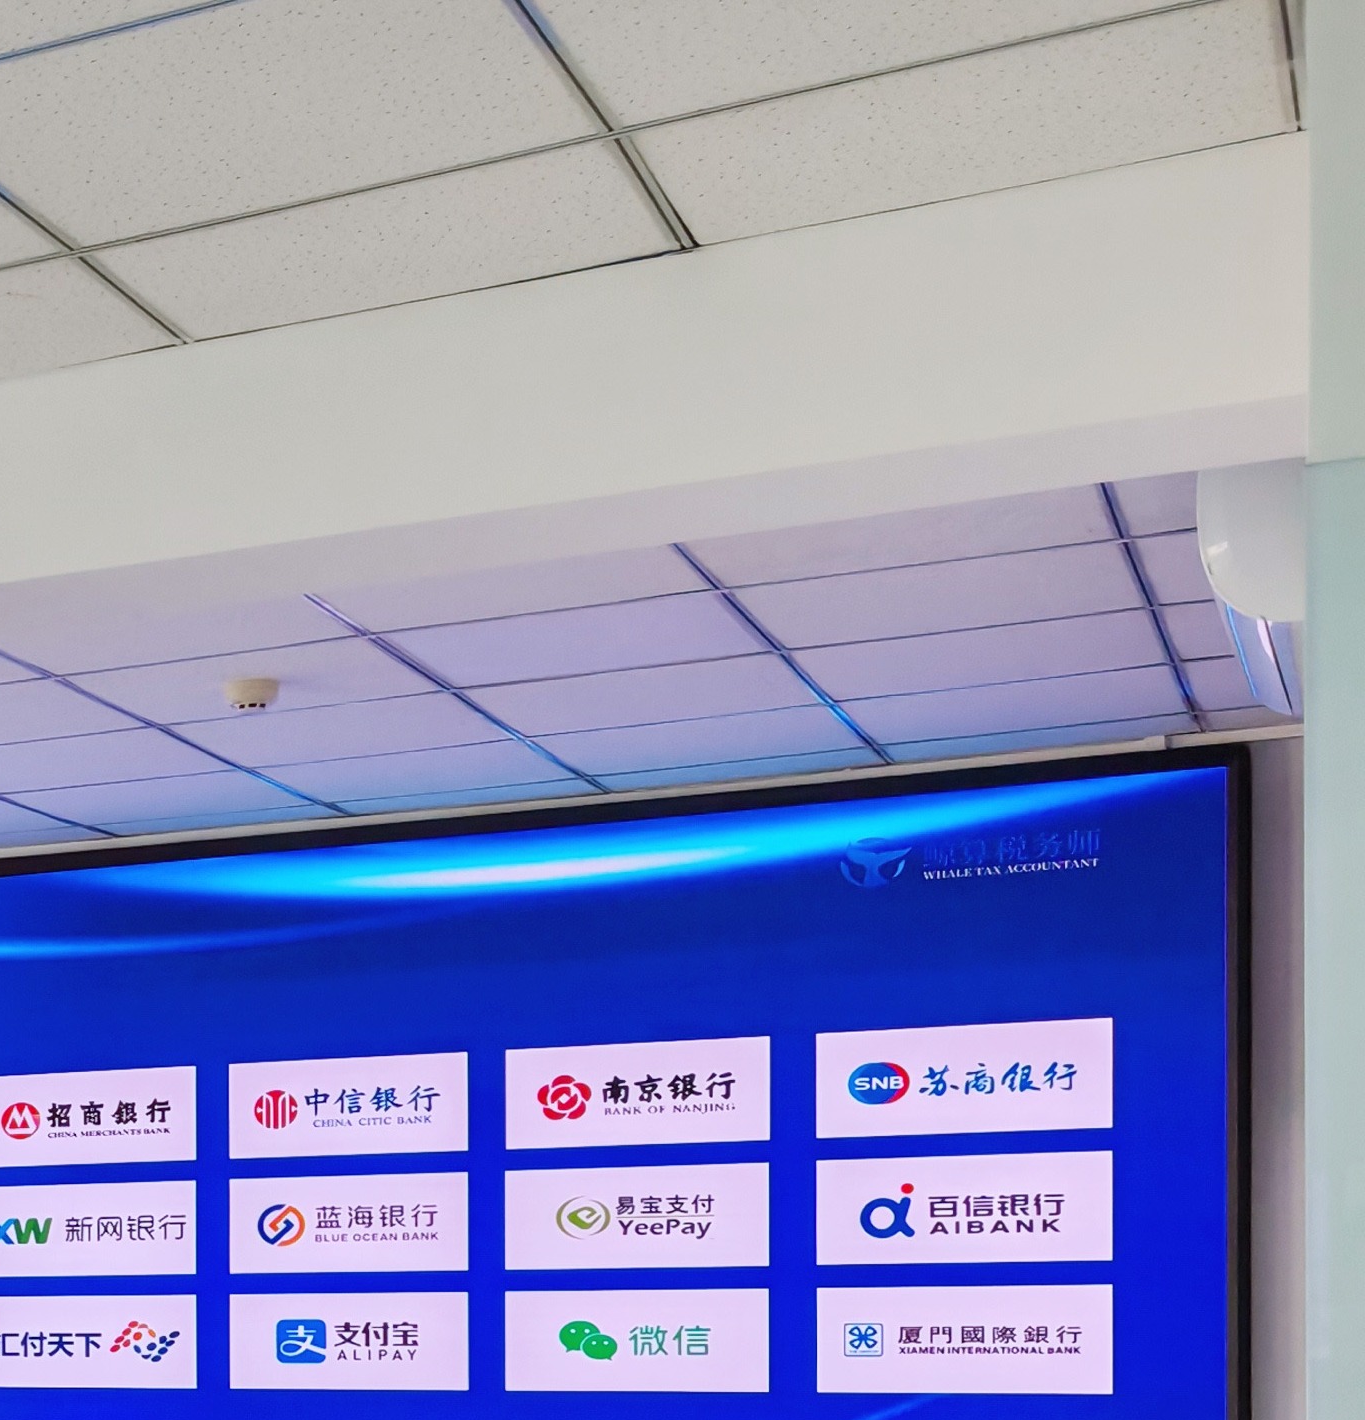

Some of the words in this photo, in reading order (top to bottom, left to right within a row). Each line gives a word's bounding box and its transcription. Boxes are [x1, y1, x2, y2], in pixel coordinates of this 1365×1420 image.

[923, 828, 1101, 867] 税务师
[922, 867, 972, 881] WHALE
[975, 865, 1002, 877] TAX
[1005, 857, 1099, 874] ACCOUNTANT
[854, 1075, 905, 1091] SNB
[919, 1061, 1077, 1096] 苏商银行
[304, 1085, 441, 1116] 中信银行
[604, 1106, 642, 1116] BANK
[648, 1105, 665, 1114] OF
[673, 1102, 736, 1114] NANJING
[312, 1119, 353, 1128] CHINA
[358, 1116, 392, 1127] CITIC
[396, 1115, 432, 1125] BANK
[47, 1131, 78, 1139] CHINA
[80, 1128, 142, 1138] MERCHANTS
[143, 1127, 171, 1135] BANK
[616, 1194, 715, 1215] 易宝支付
[928, 1193, 1065, 1218] 百信银行
[315, 1203, 438, 1229] 蓝海银行
[65, 1214, 187, 1242] 新网银行
[314, 1233, 348, 1243] BLUE
[352, 1232, 398, 1242] OCEAN
[402, 1231, 439, 1241] BANK
[617, 1218, 712, 1239] YeePay
[929, 1219, 1061, 1235] AIBANK
[334, 1321, 419, 1347] 支付宝
[629, 1325, 711, 1356] 微信
[337, 1349, 418, 1361] ALIPAY
[898, 1346, 945, 1355] XIAMEN
[947, 1346, 1044, 1355] INTERNATIONAL
[1047, 1346, 1082, 1355] BANK
